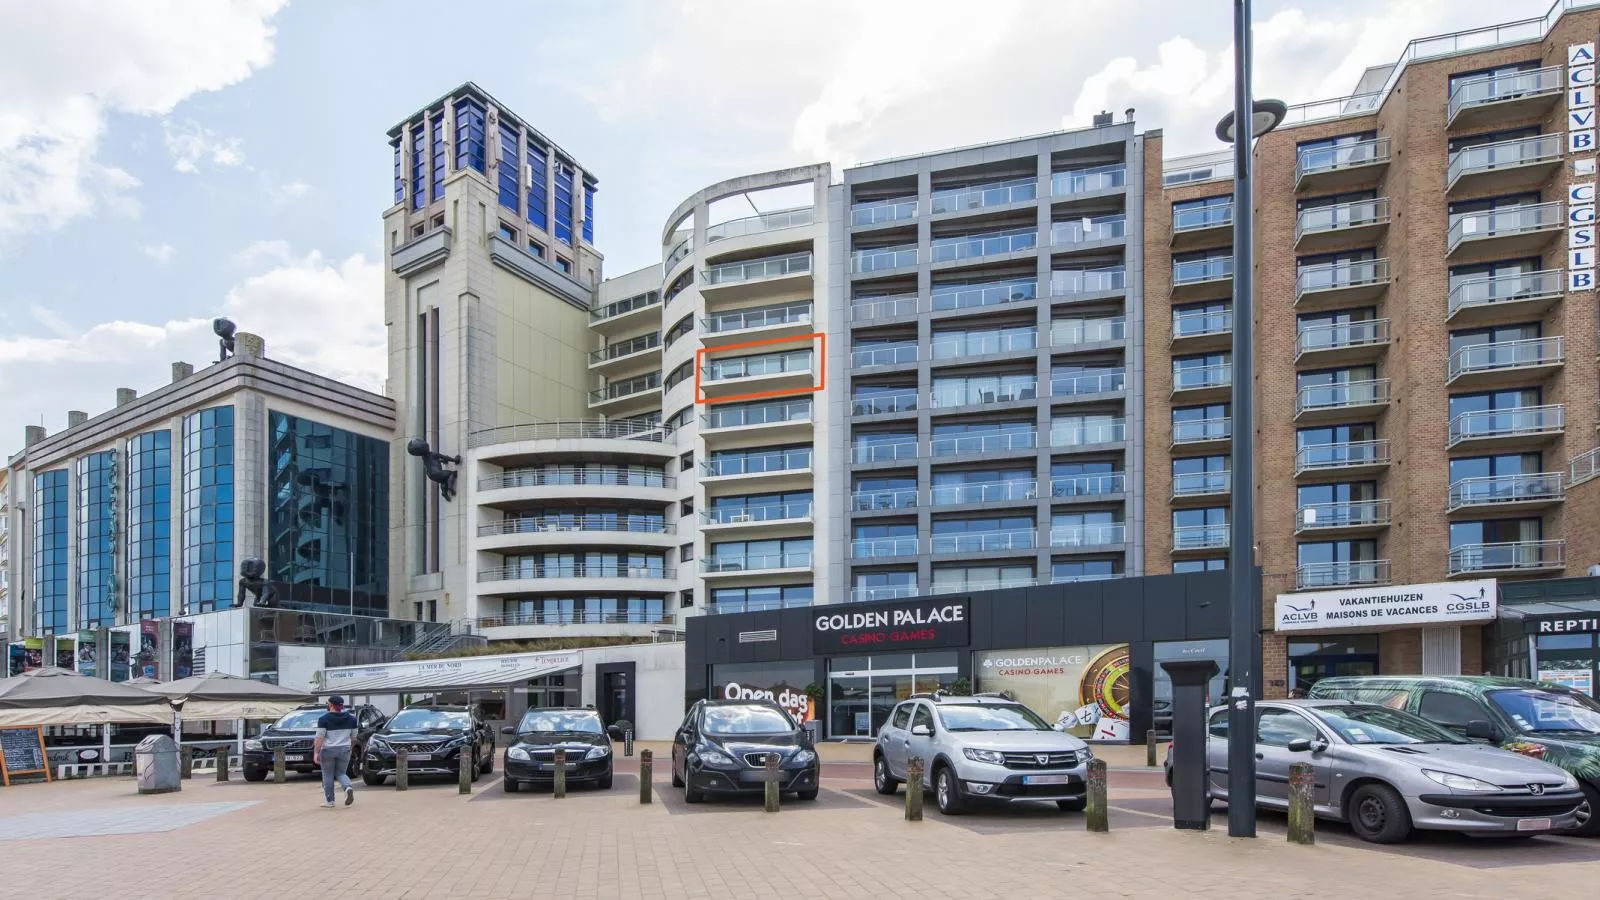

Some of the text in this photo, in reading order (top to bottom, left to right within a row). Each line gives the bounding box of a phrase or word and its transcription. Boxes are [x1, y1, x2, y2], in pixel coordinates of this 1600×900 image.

[1570, 47, 1593, 149] ACLVB
[1570, 185, 1594, 288] CGSLB
[1339, 593, 1423, 606] VAKANTIEHUIZEN
[1446, 601, 1490, 611] CGSLB
[815, 604, 964, 631] GOLDEN PALACE
[1282, 611, 1318, 621] ACLVB
[1326, 605, 1438, 620] MAISONS DE VACANCES
[1540, 618, 1598, 632] REPTI
[841, 628, 935, 645] CASINO GAMES
[995, 655, 1083, 667] GOLDENPALACE
[998, 667, 1065, 676] CASINO GAMES
[778, 688, 808, 713] dag
